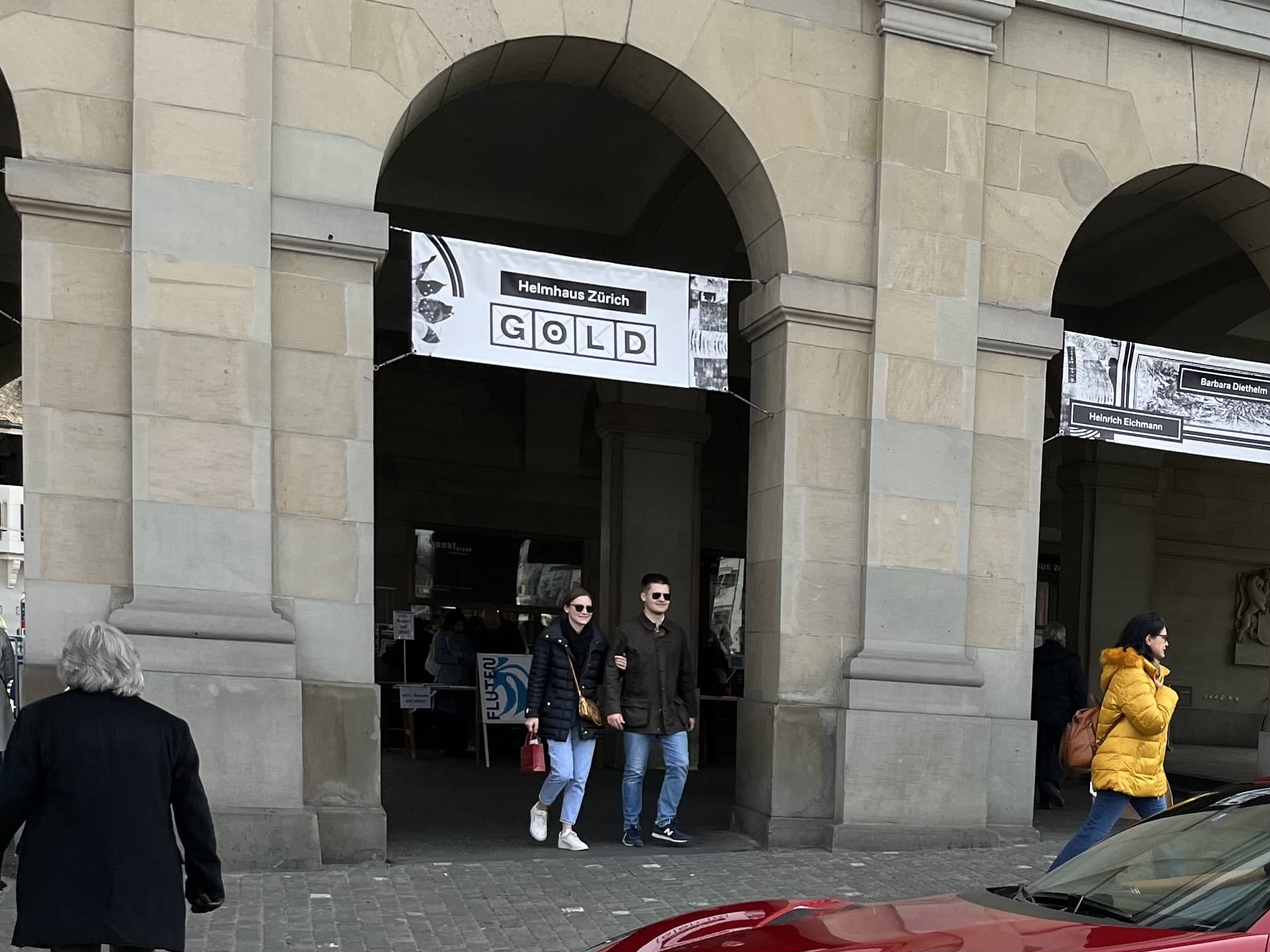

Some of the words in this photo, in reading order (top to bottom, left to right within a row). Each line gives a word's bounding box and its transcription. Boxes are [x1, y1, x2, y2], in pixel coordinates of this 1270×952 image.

[518, 279, 585, 302] Helmhaus
[587, 288, 630, 308] Zürich
[500, 314, 647, 356] GOLD
[1200, 377, 1232, 391] Barbara
[1232, 381, 1268, 396] Diethelm
[1089, 411, 1122, 426] Heinrich
[1123, 417, 1163, 432] Eichmann
